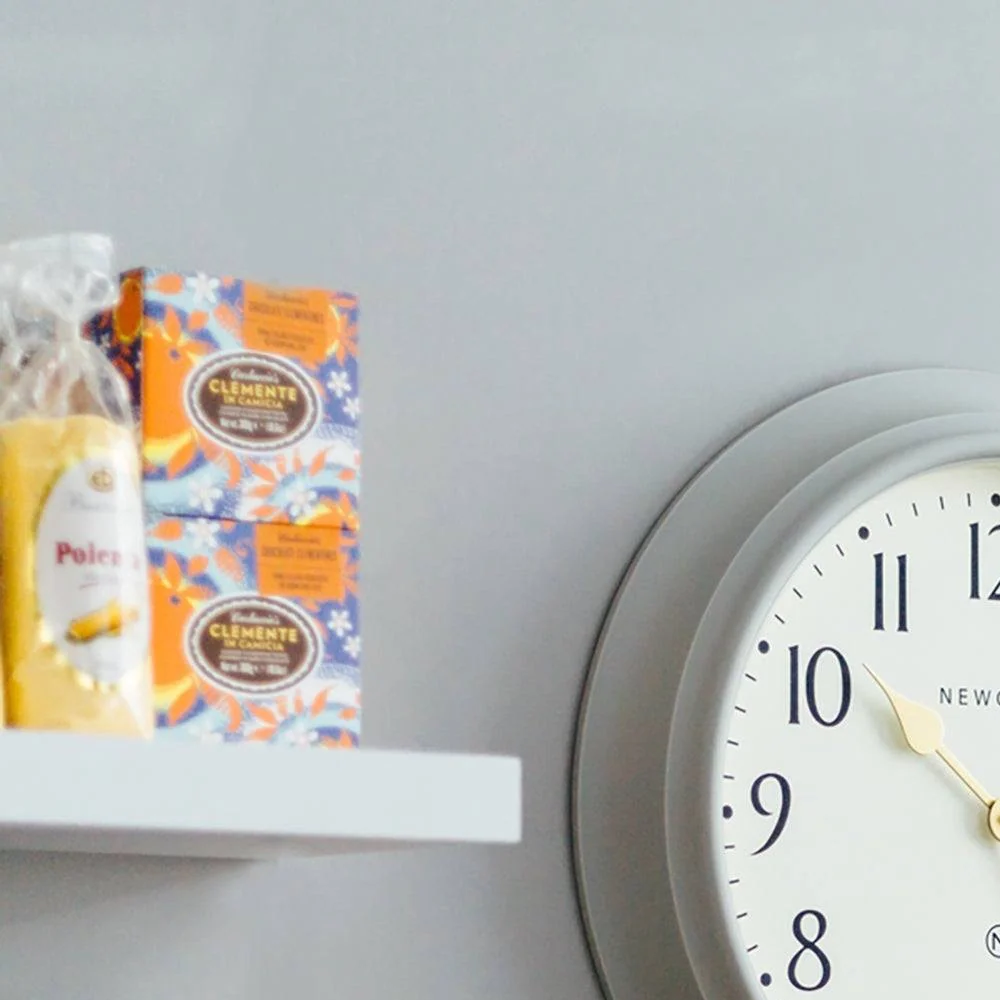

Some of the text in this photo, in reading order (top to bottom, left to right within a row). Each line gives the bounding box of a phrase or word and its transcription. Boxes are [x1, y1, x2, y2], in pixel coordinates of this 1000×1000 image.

[55, 541, 140, 570] Polena
[873, 552, 909, 632] 11
[788, 645, 852, 727] 10
[750, 772, 792, 856] 9
[787, 909, 832, 991] 8
